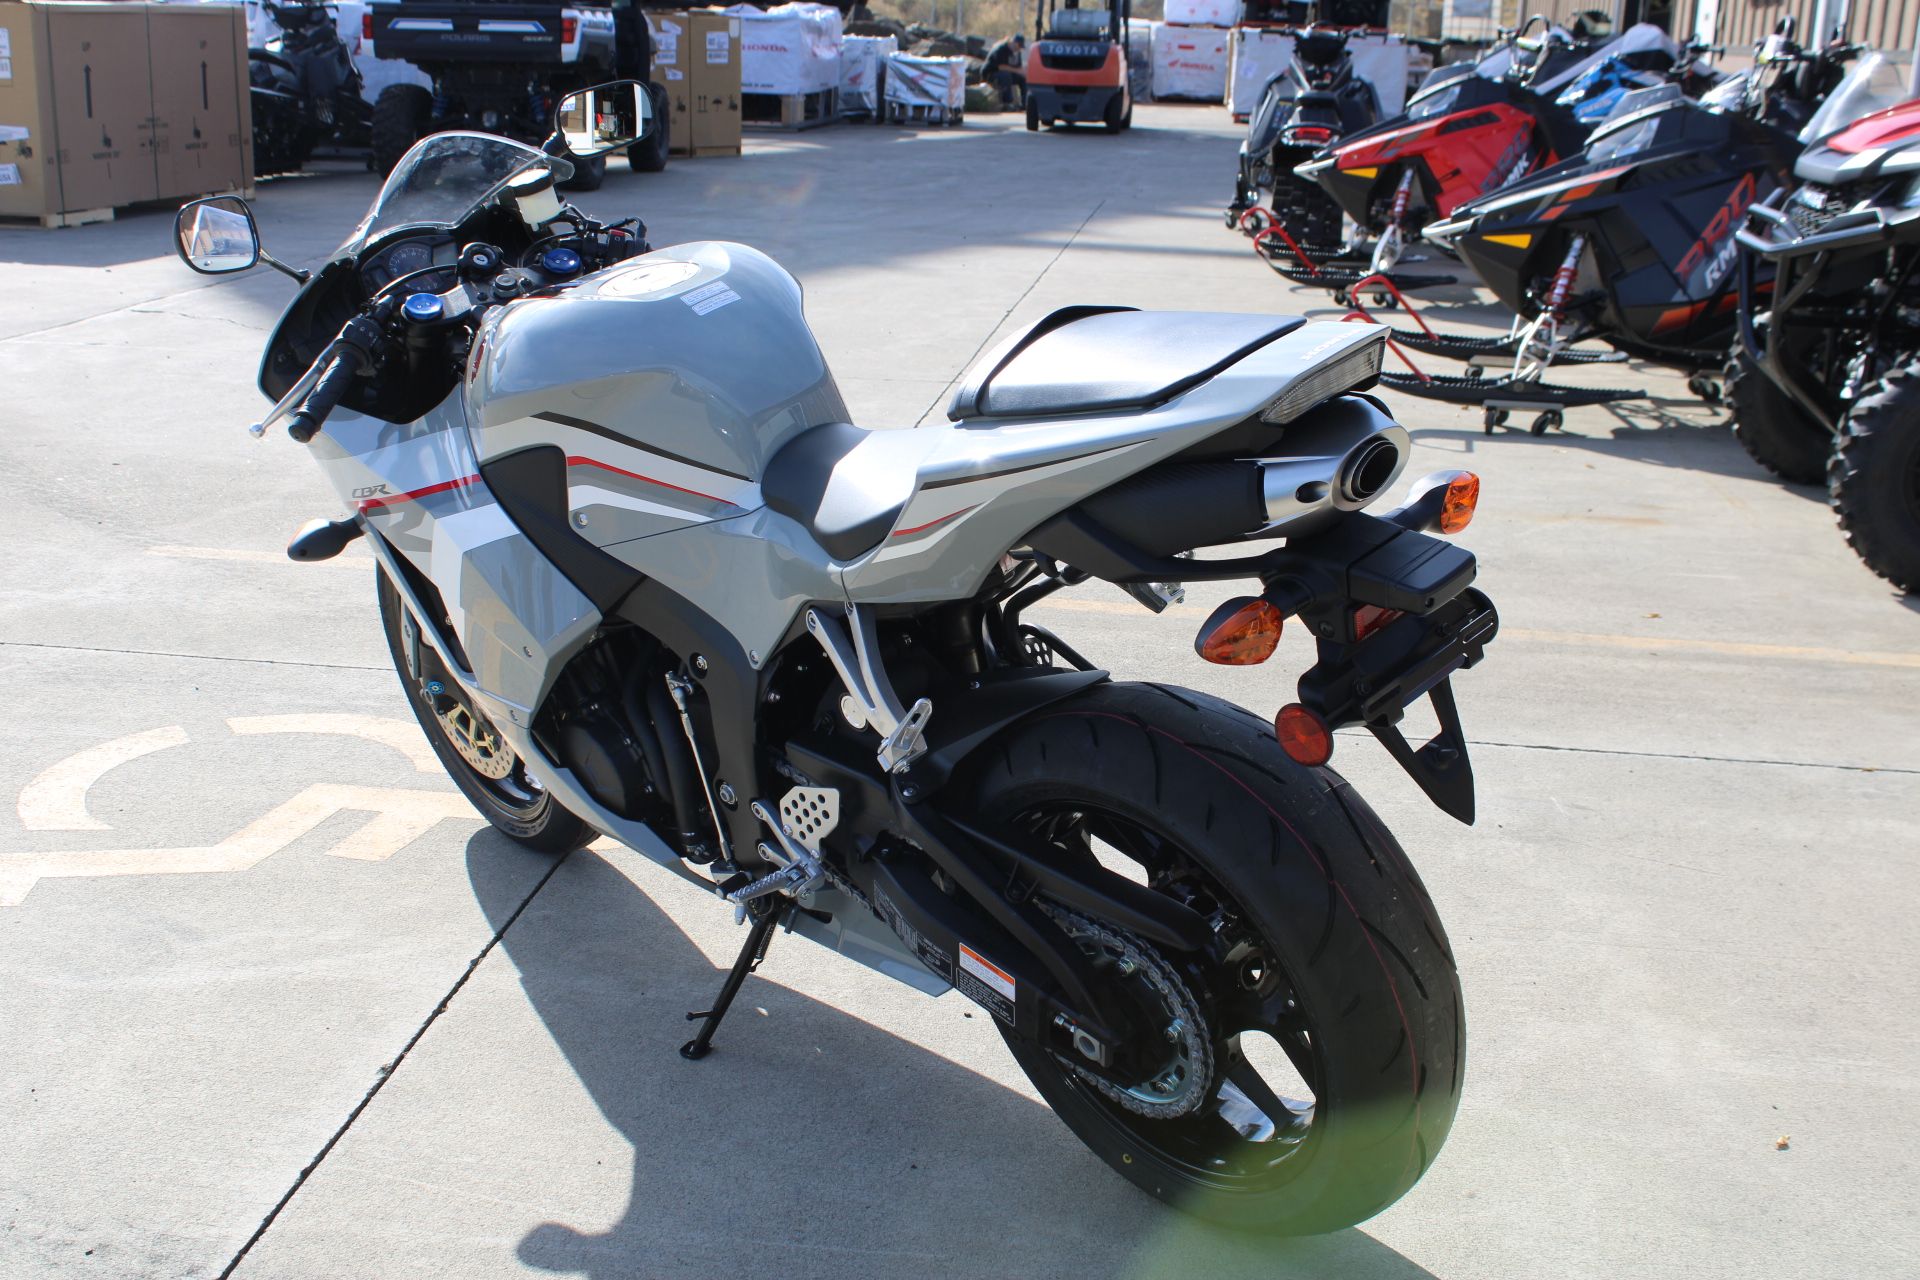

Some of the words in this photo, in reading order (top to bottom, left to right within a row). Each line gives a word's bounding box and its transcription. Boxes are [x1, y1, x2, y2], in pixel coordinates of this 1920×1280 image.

[440, 33, 491, 42] POLARIS
[742, 43, 788, 52] HONDA
[1049, 45, 1099, 55] TOYOTA
[1674, 172, 1756, 283] PRO
[1705, 238, 1738, 290] RM
[352, 483, 392, 499] CBR
